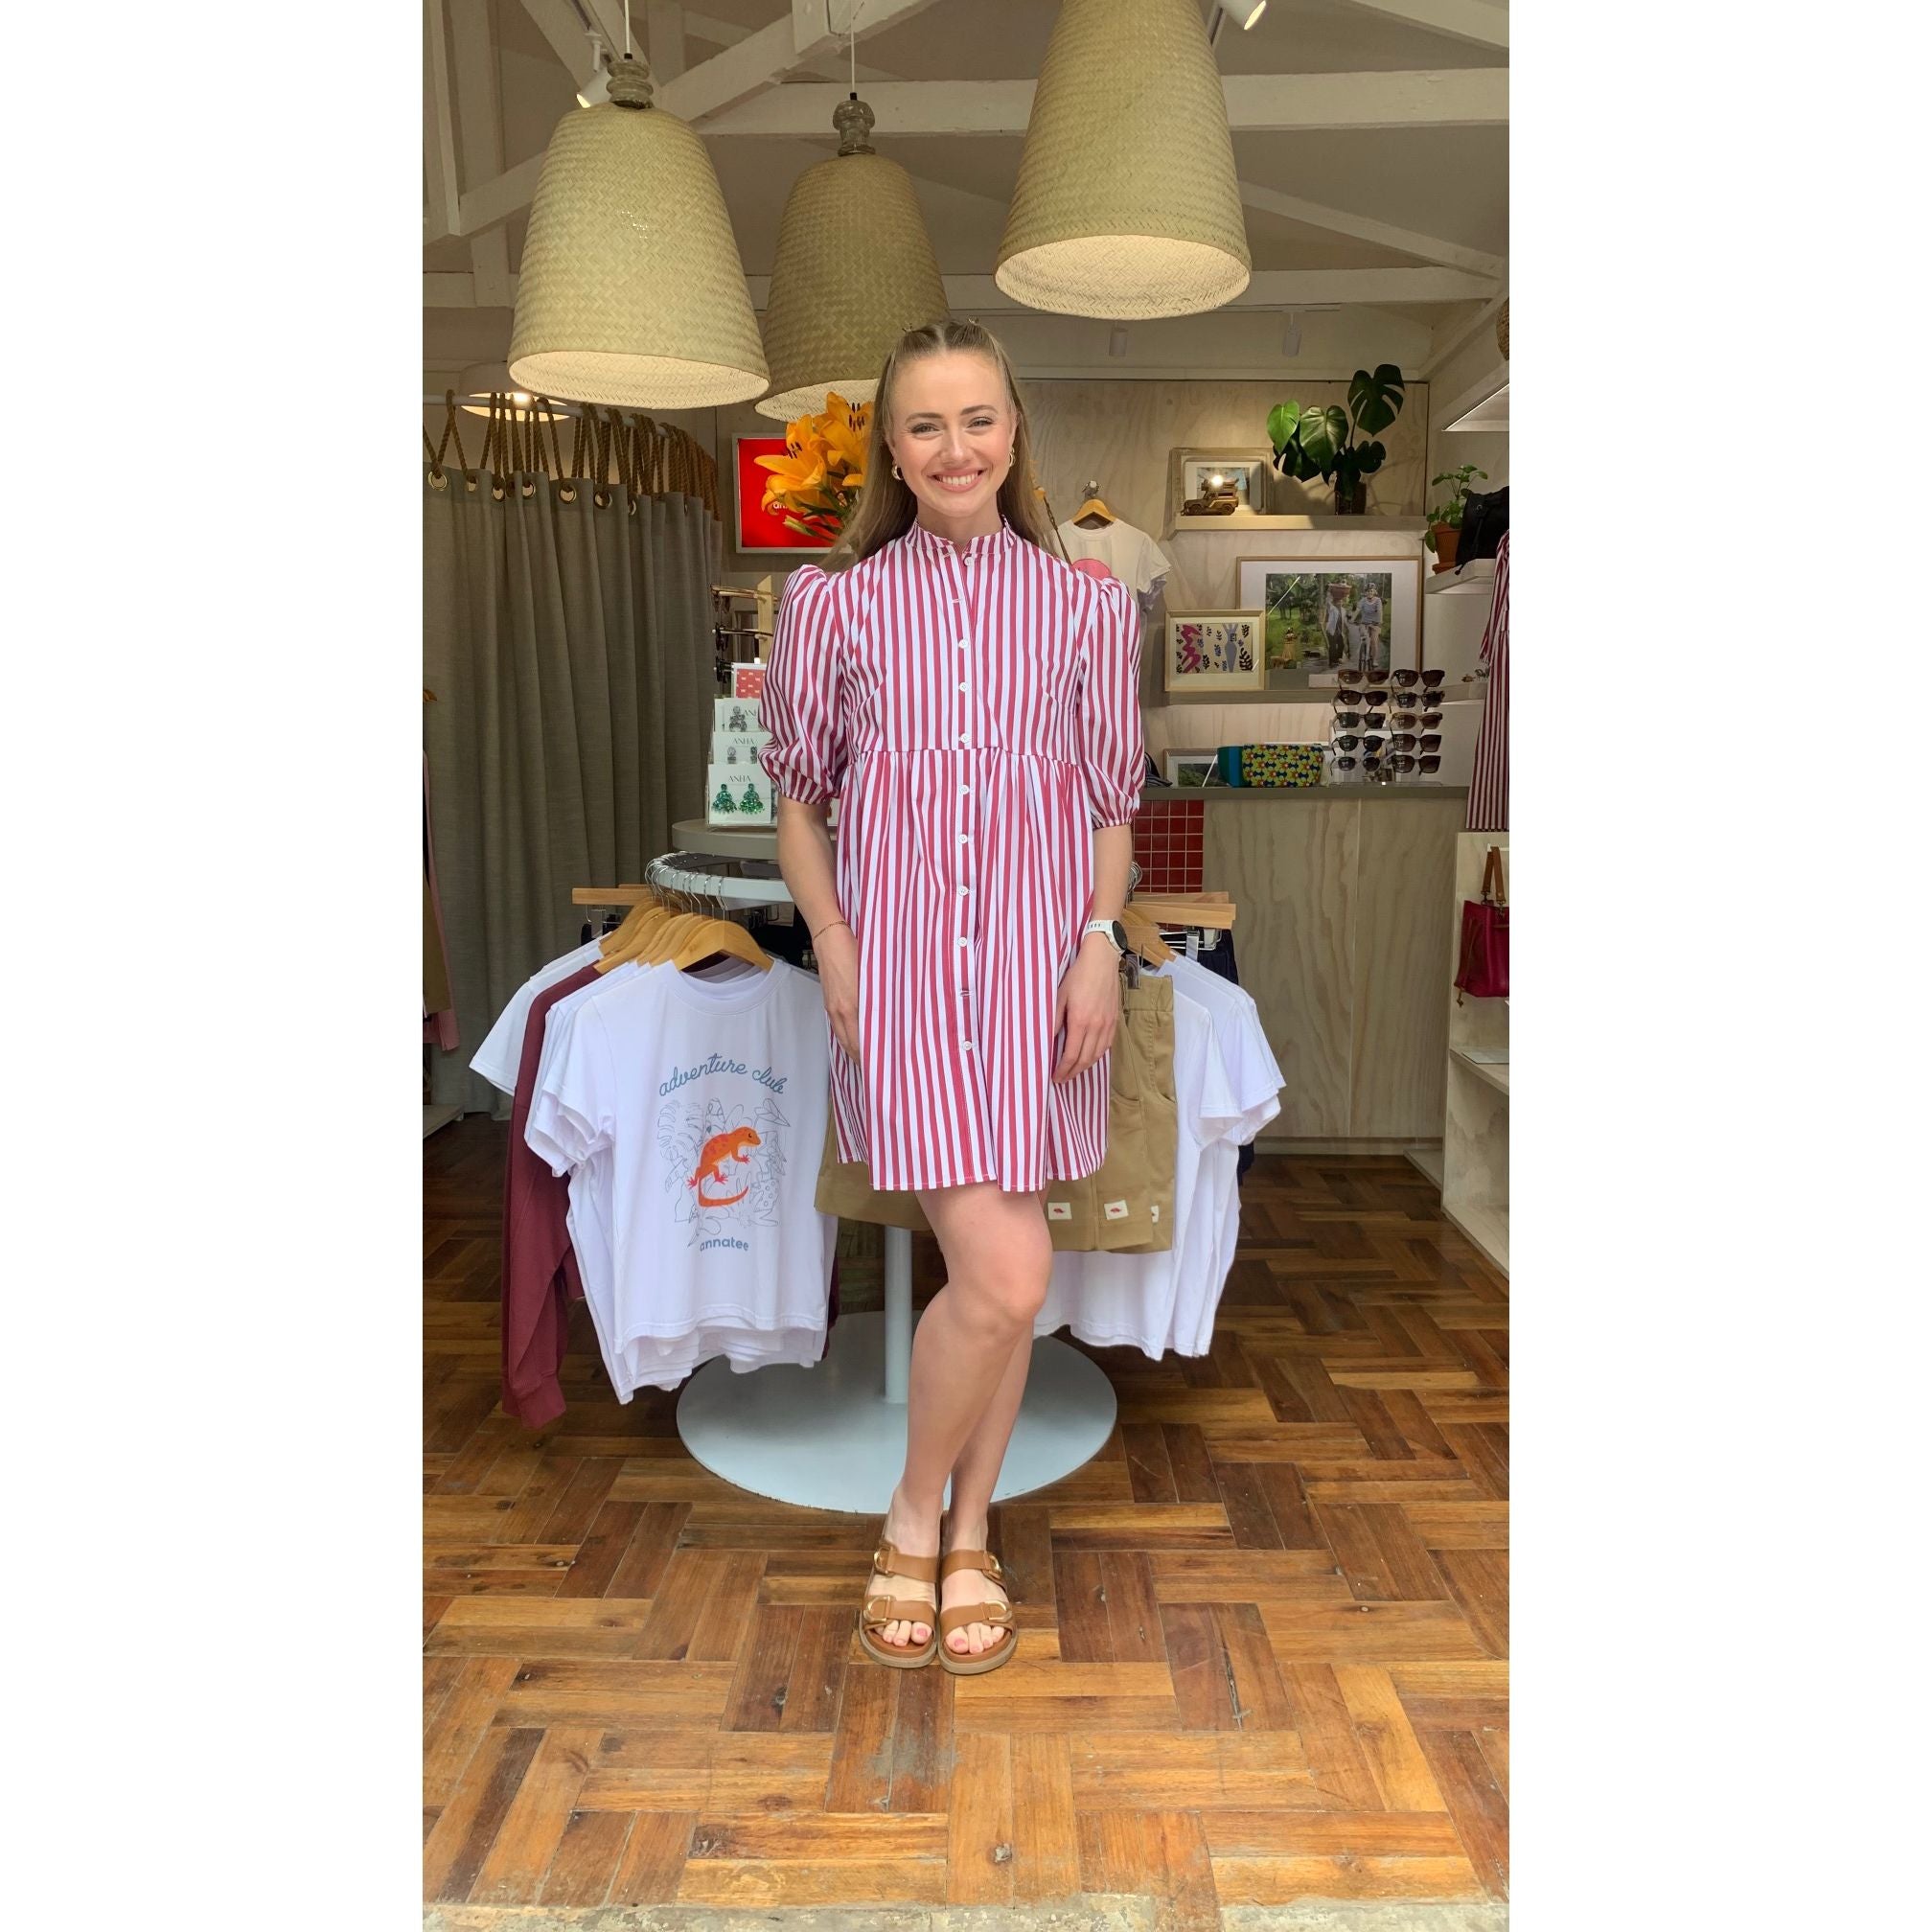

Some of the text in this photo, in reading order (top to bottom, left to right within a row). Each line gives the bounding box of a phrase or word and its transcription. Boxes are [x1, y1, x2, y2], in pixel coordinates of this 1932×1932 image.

[658, 1052, 788, 1097] adventure club
[700, 1235, 749, 1252] annatee
